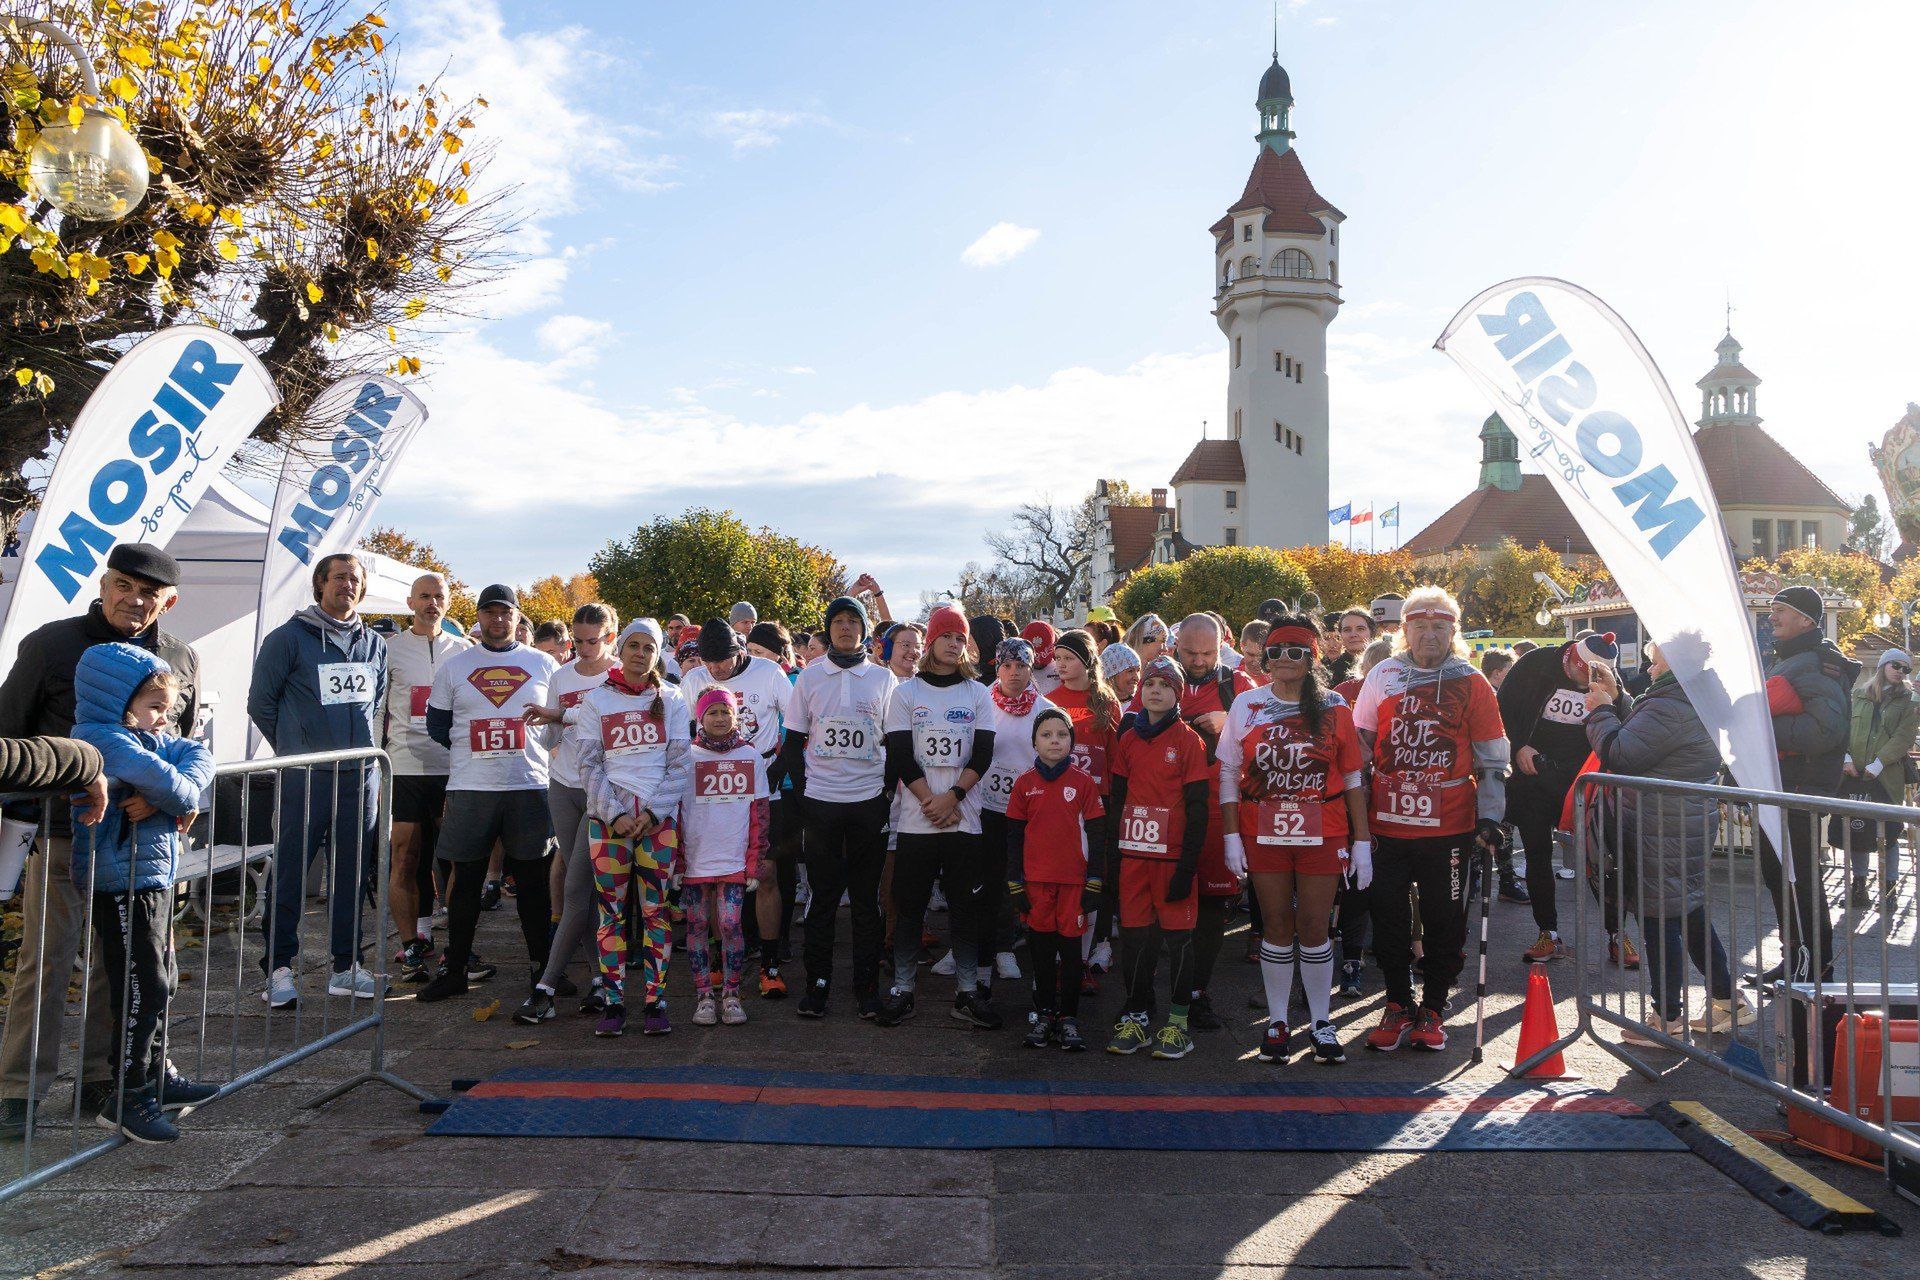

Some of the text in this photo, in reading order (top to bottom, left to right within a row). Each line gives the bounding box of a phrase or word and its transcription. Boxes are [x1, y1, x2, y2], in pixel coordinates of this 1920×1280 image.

[34, 339, 243, 604] MOSIR
[278, 382, 403, 566] MOSIR
[138, 431, 218, 544] sopot
[347, 442, 393, 524] sopot
[329, 675, 367, 694] 342
[1549, 698, 1584, 717] 303
[477, 729, 515, 750] 151
[610, 723, 659, 748] 208
[824, 728, 864, 749] 330
[1266, 725, 1290, 740] TU
[926, 737, 962, 757] 331
[703, 773, 748, 795] 209
[990, 774, 1014, 795] 33
[1388, 792, 1432, 817] 199
[1124, 818, 1160, 843] 108
[1273, 813, 1306, 836] 52
